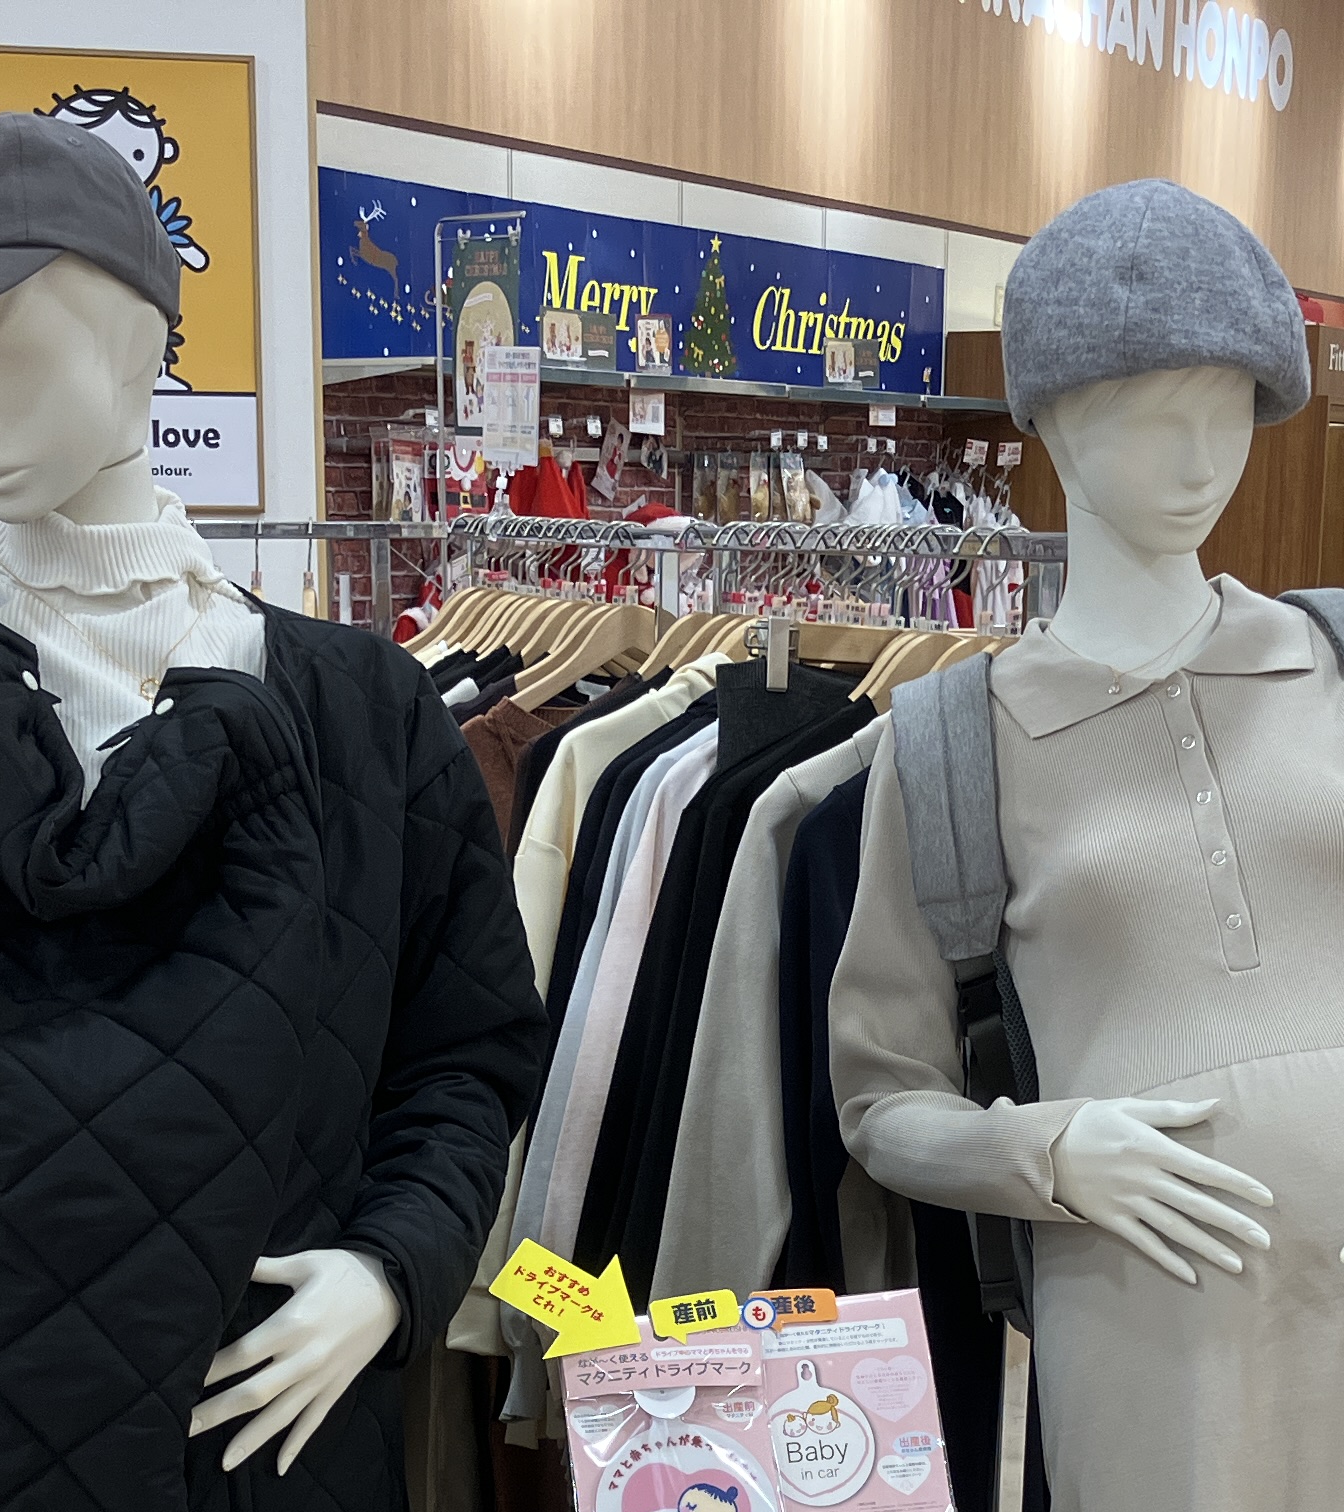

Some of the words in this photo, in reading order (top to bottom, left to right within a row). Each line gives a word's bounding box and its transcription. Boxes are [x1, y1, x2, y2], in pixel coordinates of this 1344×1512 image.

[1173, 0, 1293, 111] HONPO
[537, 250, 659, 352] Merry
[752, 285, 905, 363] Christmas
[152, 419, 220, 449] love
[513, 1265, 604, 1322] ドライブマークは
[544, 1266, 590, 1297] おすすめ
[533, 1293, 565, 1317] これ!
[671, 1299, 717, 1325] 産前
[752, 1306, 766, 1322] も
[770, 1295, 816, 1315] 産後
[577, 1367, 648, 1385] マタニティ
[654, 1361, 751, 1380] ドライブマーク
[722, 1400, 755, 1412] 出産前
[786, 1440, 848, 1464] Baby
[899, 1436, 931, 1447] 出産後
[800, 1468, 813, 1480] in
[818, 1467, 839, 1478] car
